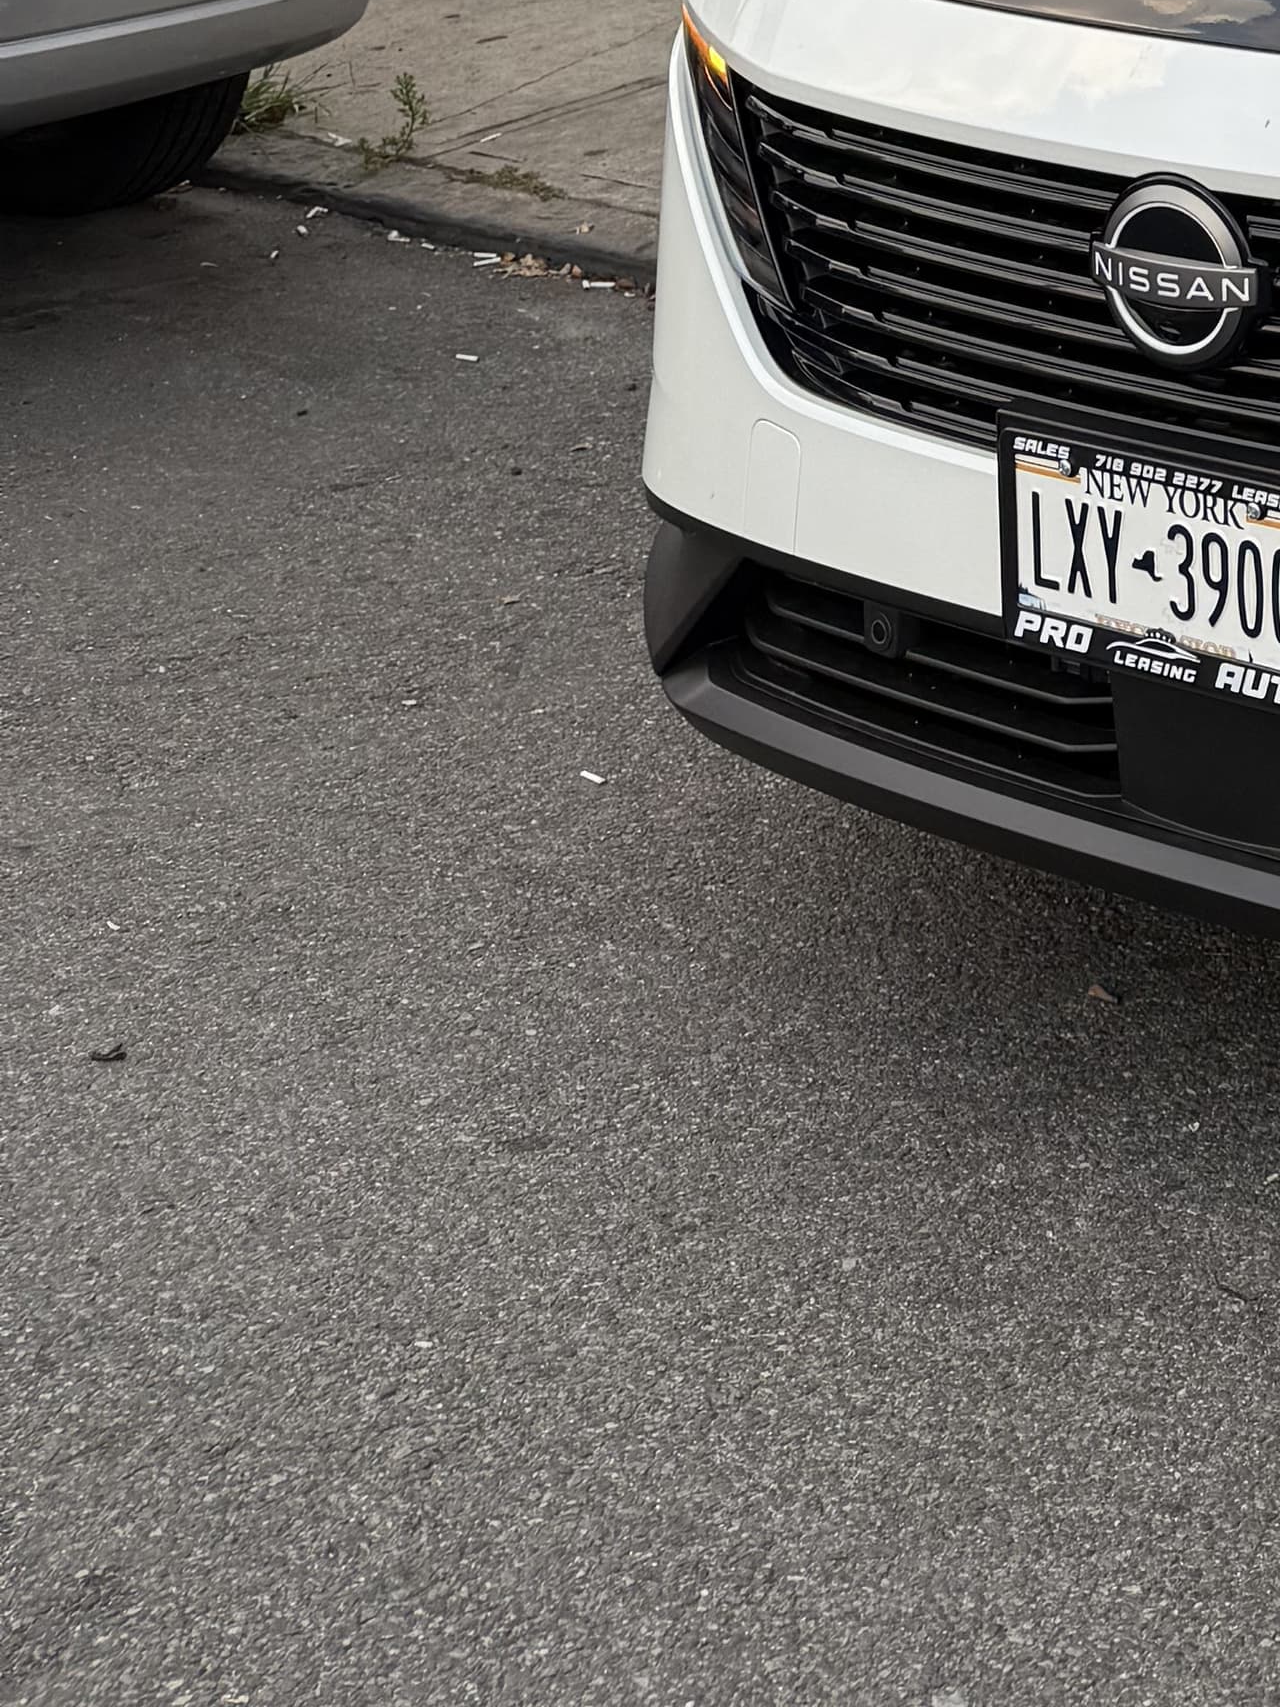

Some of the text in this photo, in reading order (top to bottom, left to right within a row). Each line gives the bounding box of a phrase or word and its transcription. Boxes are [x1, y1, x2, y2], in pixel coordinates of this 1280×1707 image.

[1095, 251, 1250, 302] NISSAN
[1013, 437, 1070, 459] SALES
[1094, 454, 1123, 472] 718
[1130, 461, 1167, 482] 902
[1172, 472, 1224, 493] 2277
[1081, 468, 1247, 530] NEW YORK
[1013, 611, 1094, 654] PRO
[1113, 649, 1198, 684] LEASING
